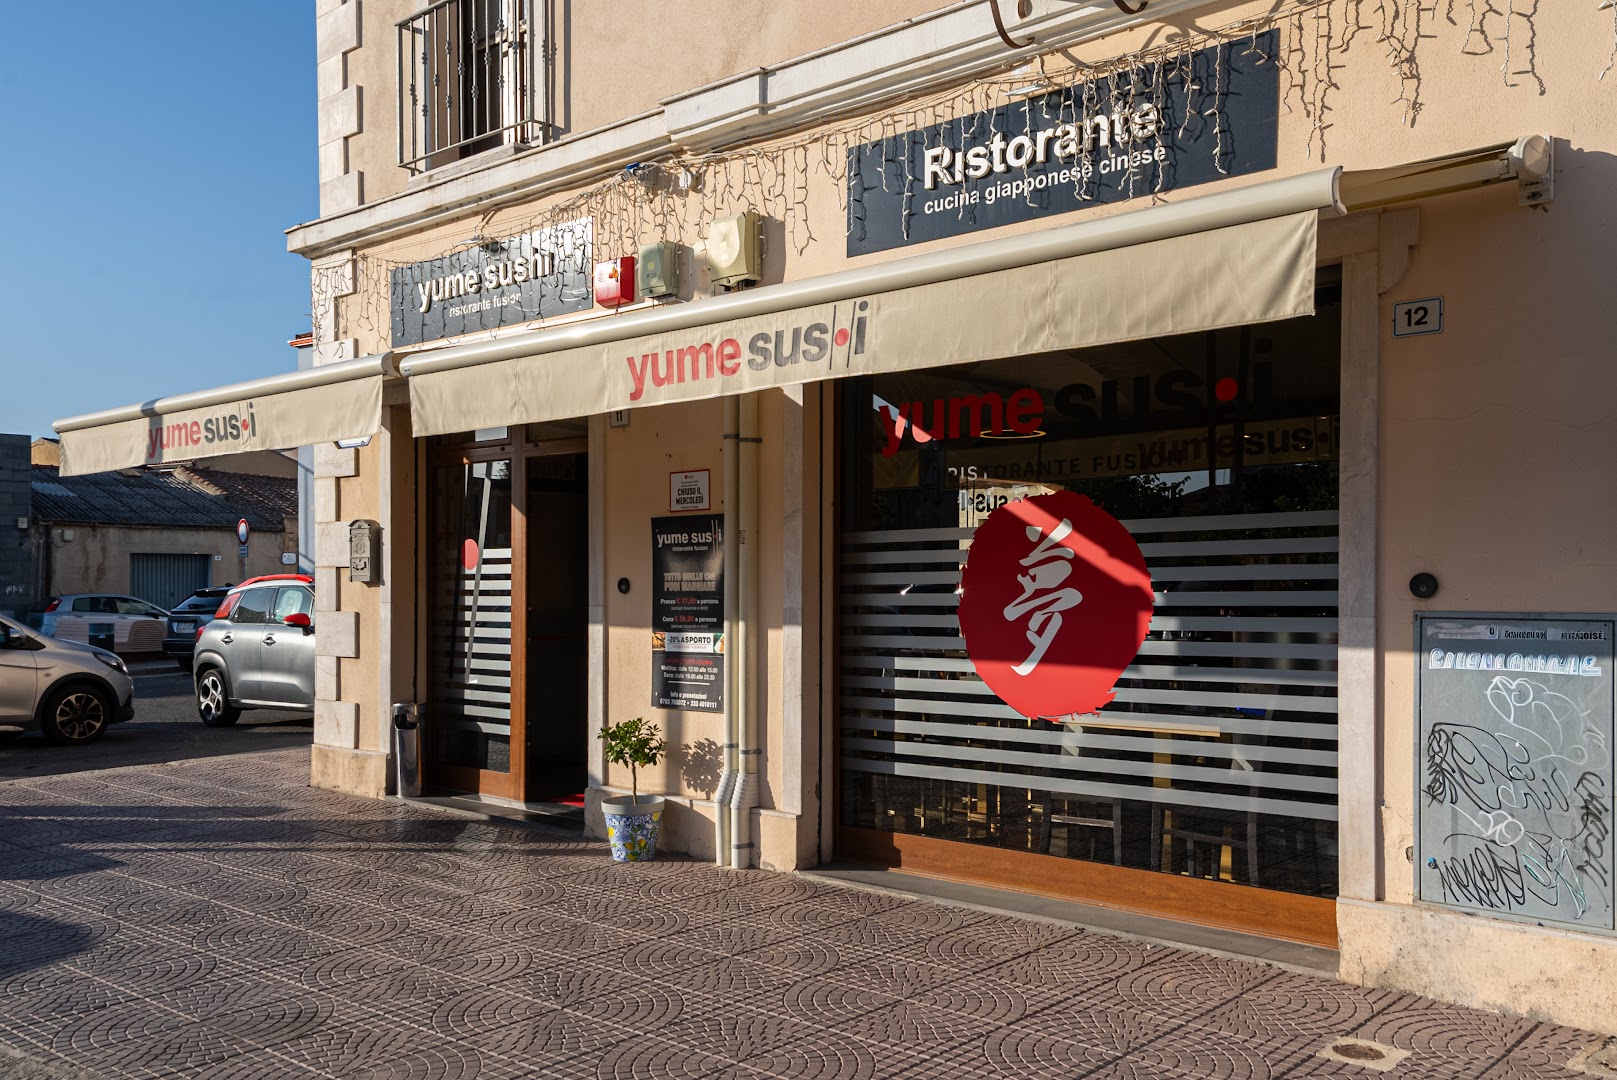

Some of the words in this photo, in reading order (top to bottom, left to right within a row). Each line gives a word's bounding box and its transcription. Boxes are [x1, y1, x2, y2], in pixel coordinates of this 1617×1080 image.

[923, 102, 1159, 190] Ristorante
[924, 190, 980, 215] cucina
[985, 163, 1095, 205] giapponese
[1099, 146, 1167, 175] cinese
[418, 268, 481, 313] yume
[485, 246, 555, 289] sushi
[449, 299, 491, 318] ristorante
[492, 291, 522, 310] fusion
[1404, 306, 1428, 327] 12
[626, 338, 742, 401] yume
[148, 420, 201, 459] yume
[880, 387, 1044, 457] yume
[947, 457, 1081, 481] RISTORANTE
[1092, 450, 1182, 474] FUSION
[678, 487, 696, 496] CHIUSO
[697, 487, 702, 495] IL
[657, 533, 689, 548] yume
